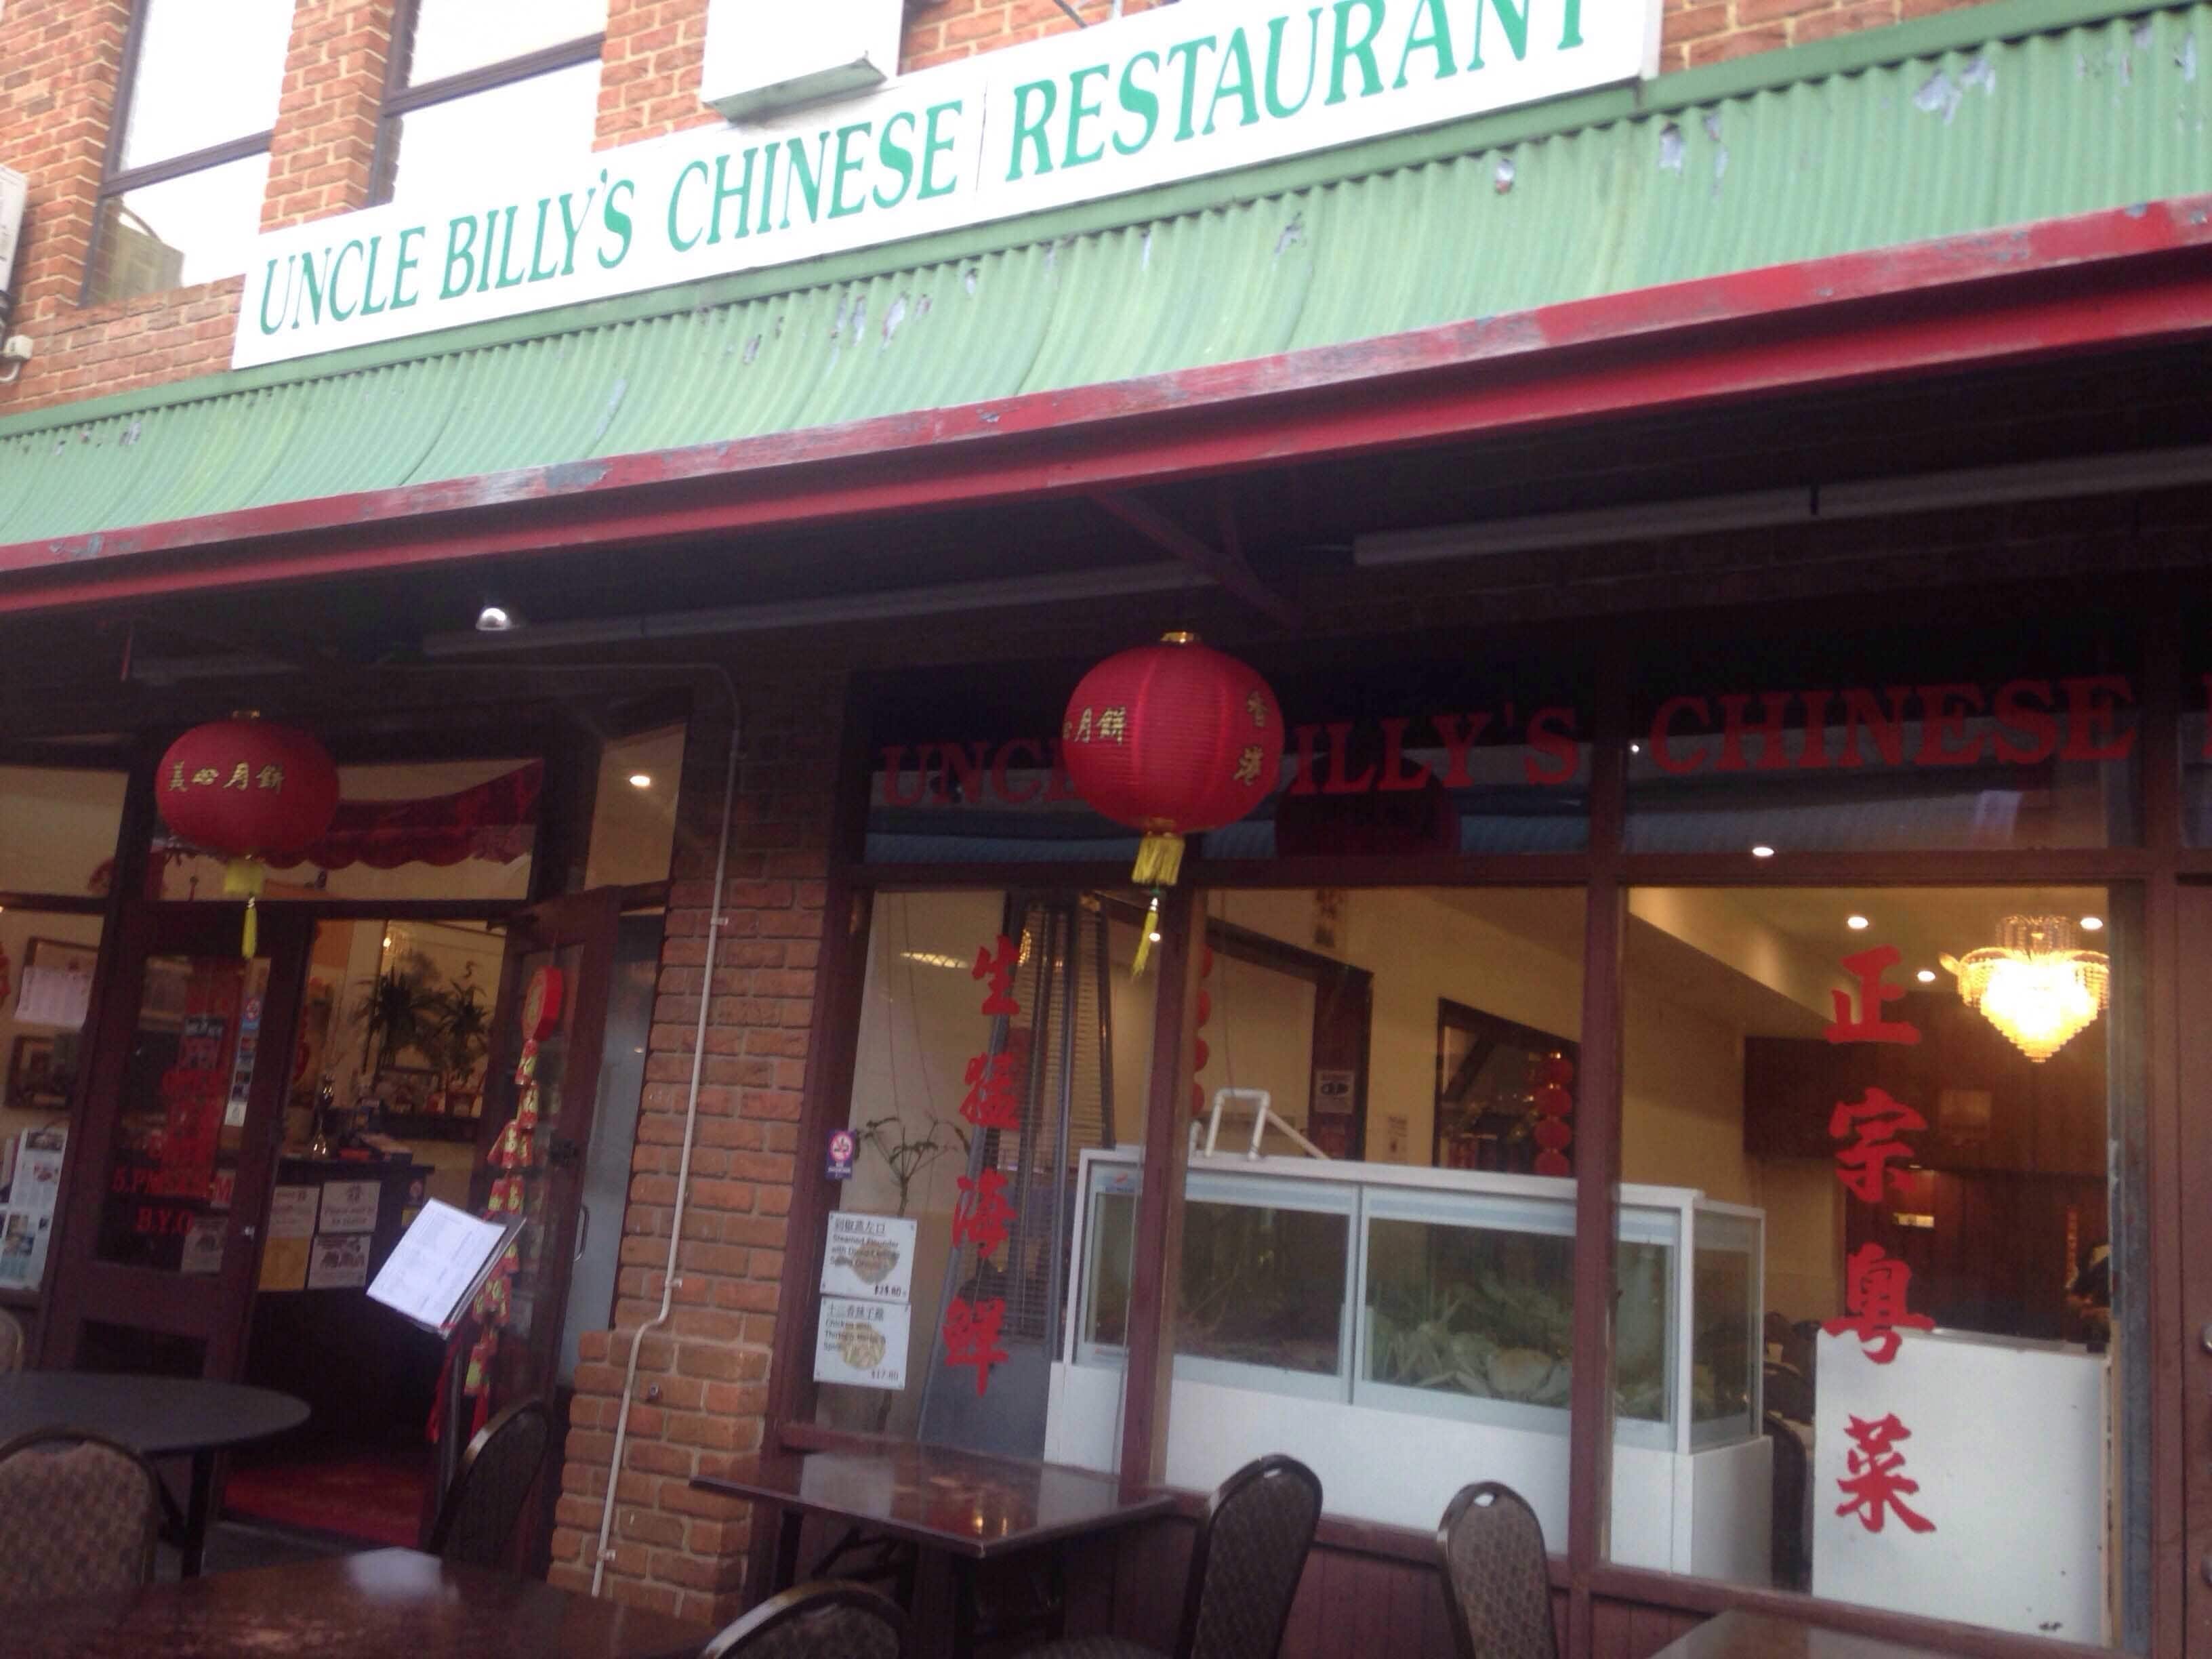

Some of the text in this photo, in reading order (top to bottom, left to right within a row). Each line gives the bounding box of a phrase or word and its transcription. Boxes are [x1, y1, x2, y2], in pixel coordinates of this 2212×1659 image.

[260, 226, 426, 335] UNCLE
[439, 169, 636, 300] BILLY'S
[667, 99, 963, 252] CHINESE
[880, 737, 1086, 806] UNCL
[1286, 701, 1580, 795] ILLY'S
[1649, 675, 2136, 775] CHINESE
